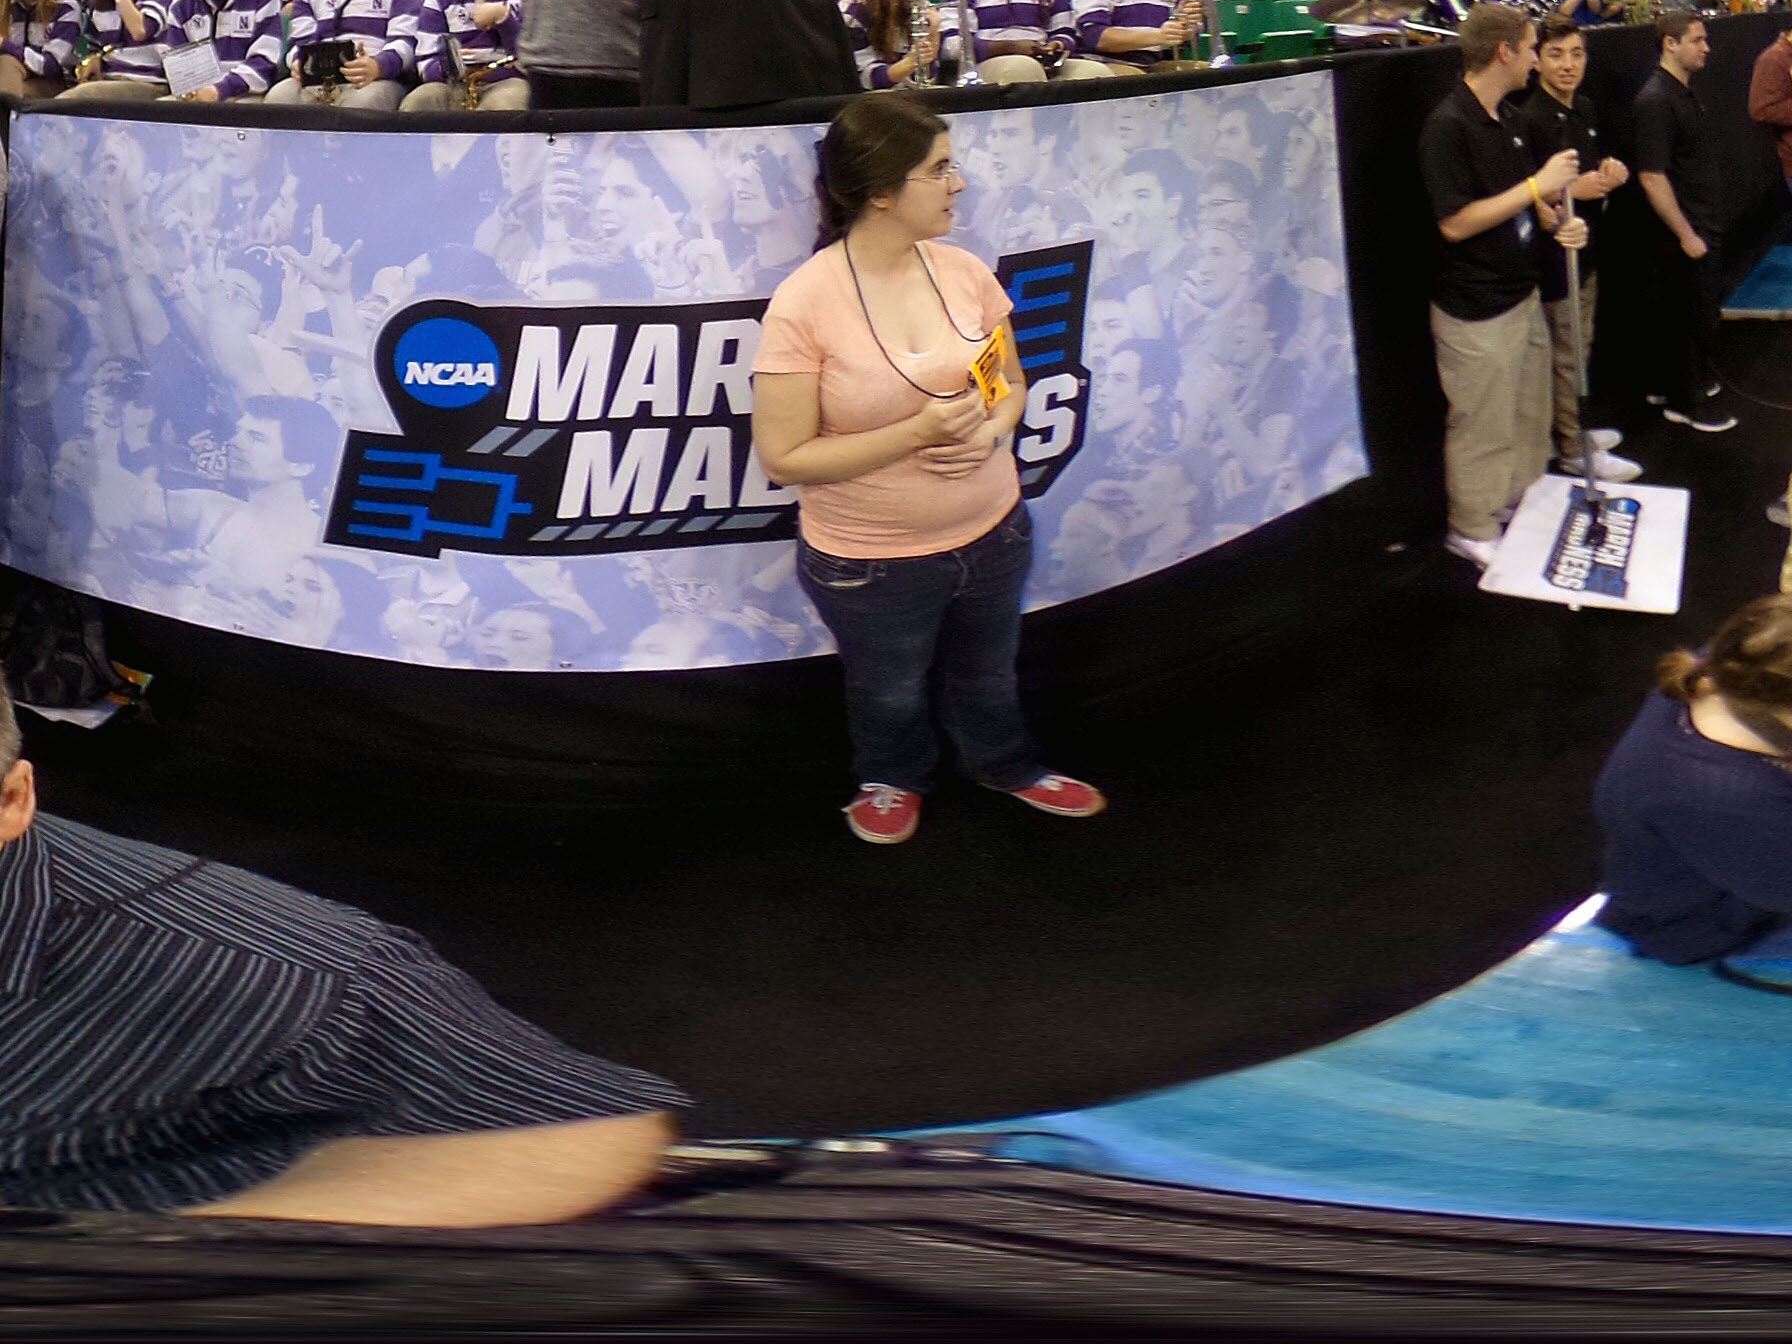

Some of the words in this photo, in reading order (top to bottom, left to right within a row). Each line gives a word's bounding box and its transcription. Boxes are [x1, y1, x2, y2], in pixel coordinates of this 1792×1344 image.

[239, 16, 249, 29] N
[403, 361, 497, 387] NCAA
[505, 318, 758, 422] MAR
[1594, 510, 1636, 568] MARCH
